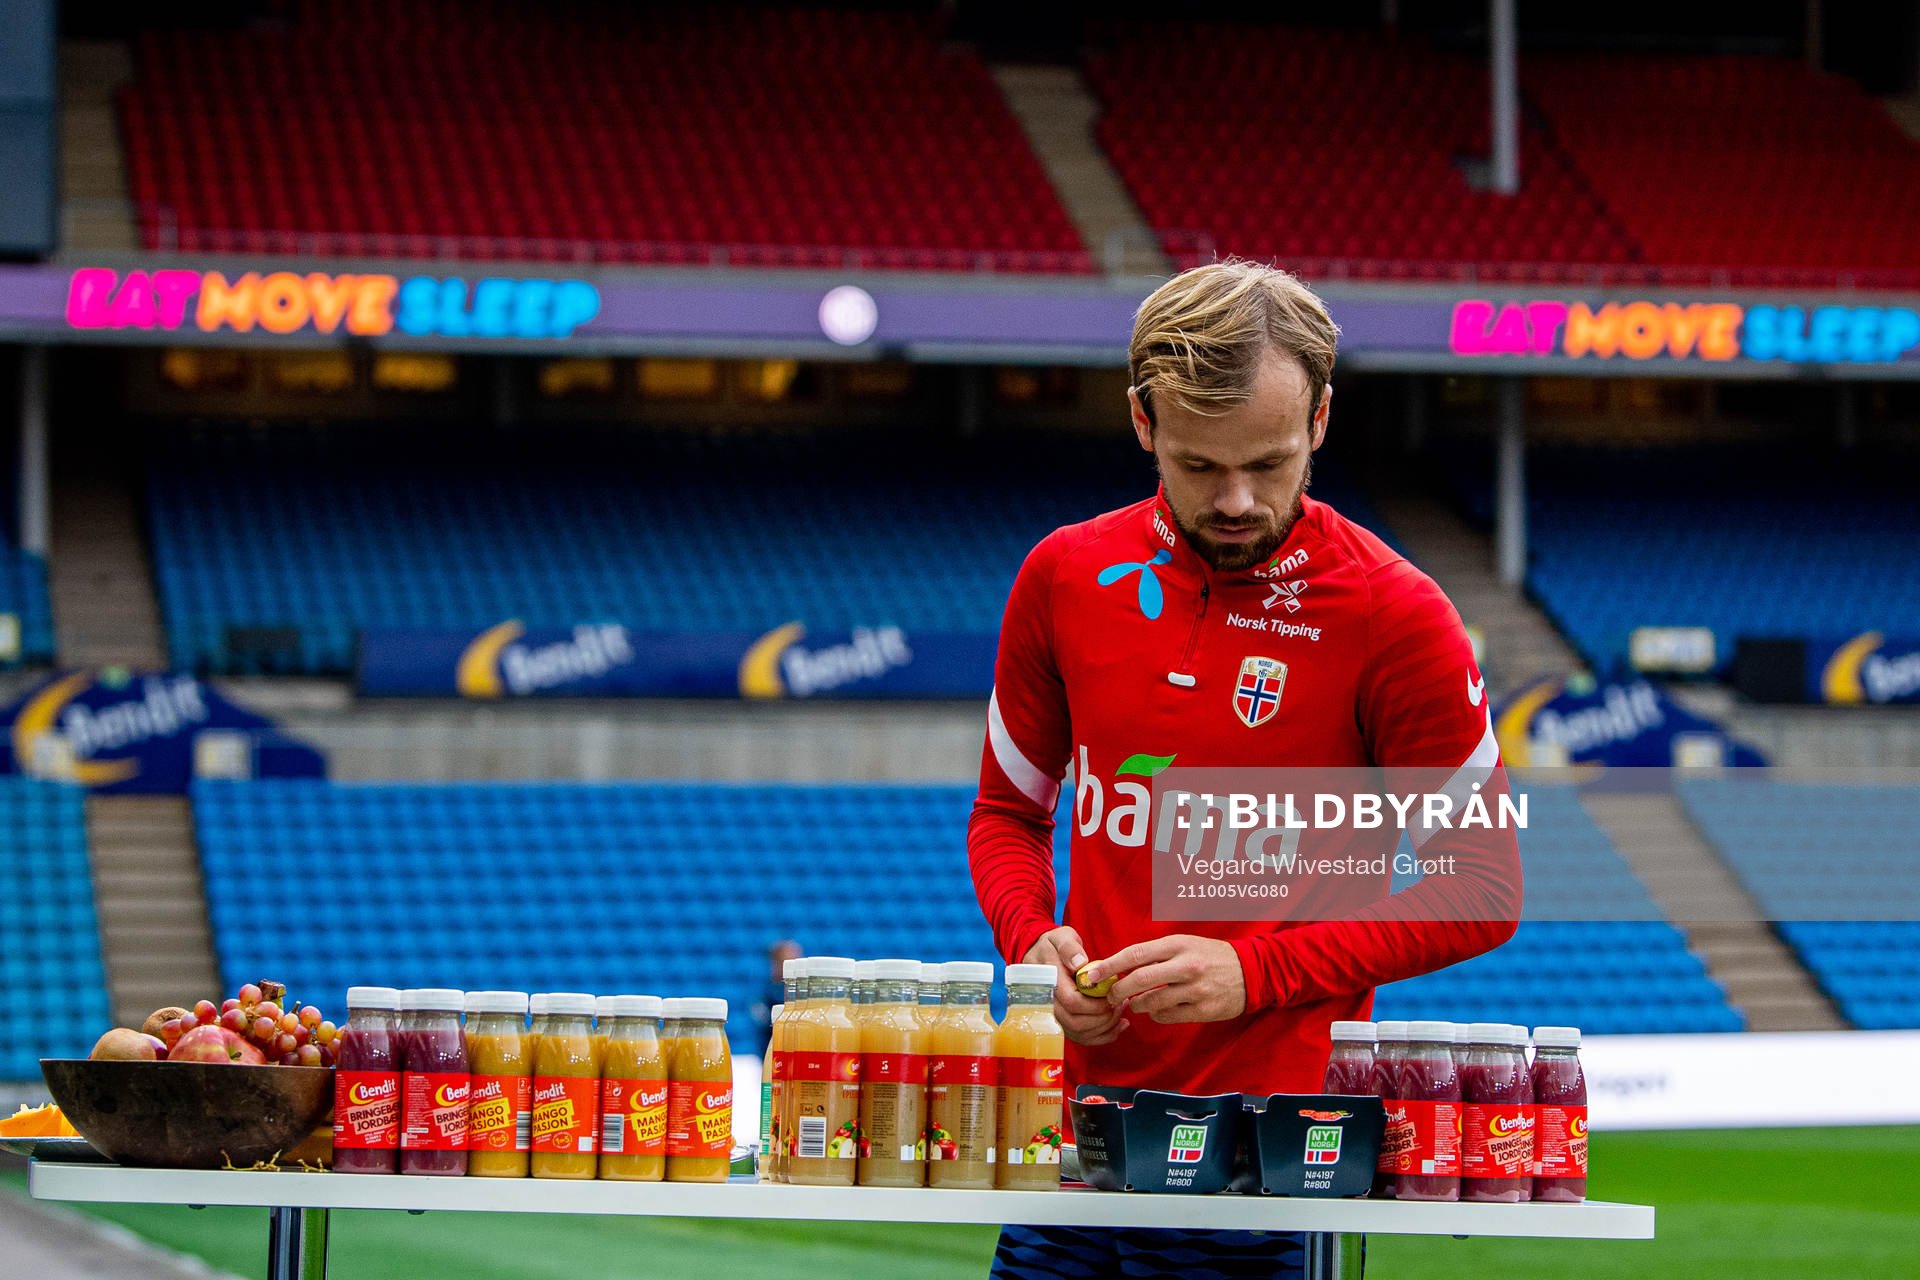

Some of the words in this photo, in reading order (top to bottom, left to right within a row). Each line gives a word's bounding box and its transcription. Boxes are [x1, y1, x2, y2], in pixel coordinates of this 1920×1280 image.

[66, 267, 201, 329] EAT
[196, 270, 397, 335] MOVE
[398, 275, 600, 339] SLEEP
[1450, 300, 1568, 355] EAT
[1564, 302, 1743, 360] MOVE
[1742, 304, 1920, 363] SLEEP
[1226, 612, 1268, 633] Norsk
[1270, 617, 1322, 641] Tipping
[1076, 744, 1301, 867] bama
[360, 1078, 396, 1099] Bendit
[470, 1081, 502, 1099] endit
[1176, 1128, 1204, 1140] NYT
[1311, 1130, 1339, 1141] NYT
[1175, 1139, 1200, 1148] NORGE
[1311, 1141, 1336, 1149] NORGE
[1168, 1168, 1197, 1177] N#4197
[1305, 1171, 1335, 1180] N#4197
[1166, 1177, 1192, 1187] R#800
[1304, 1180, 1331, 1189] R#800
